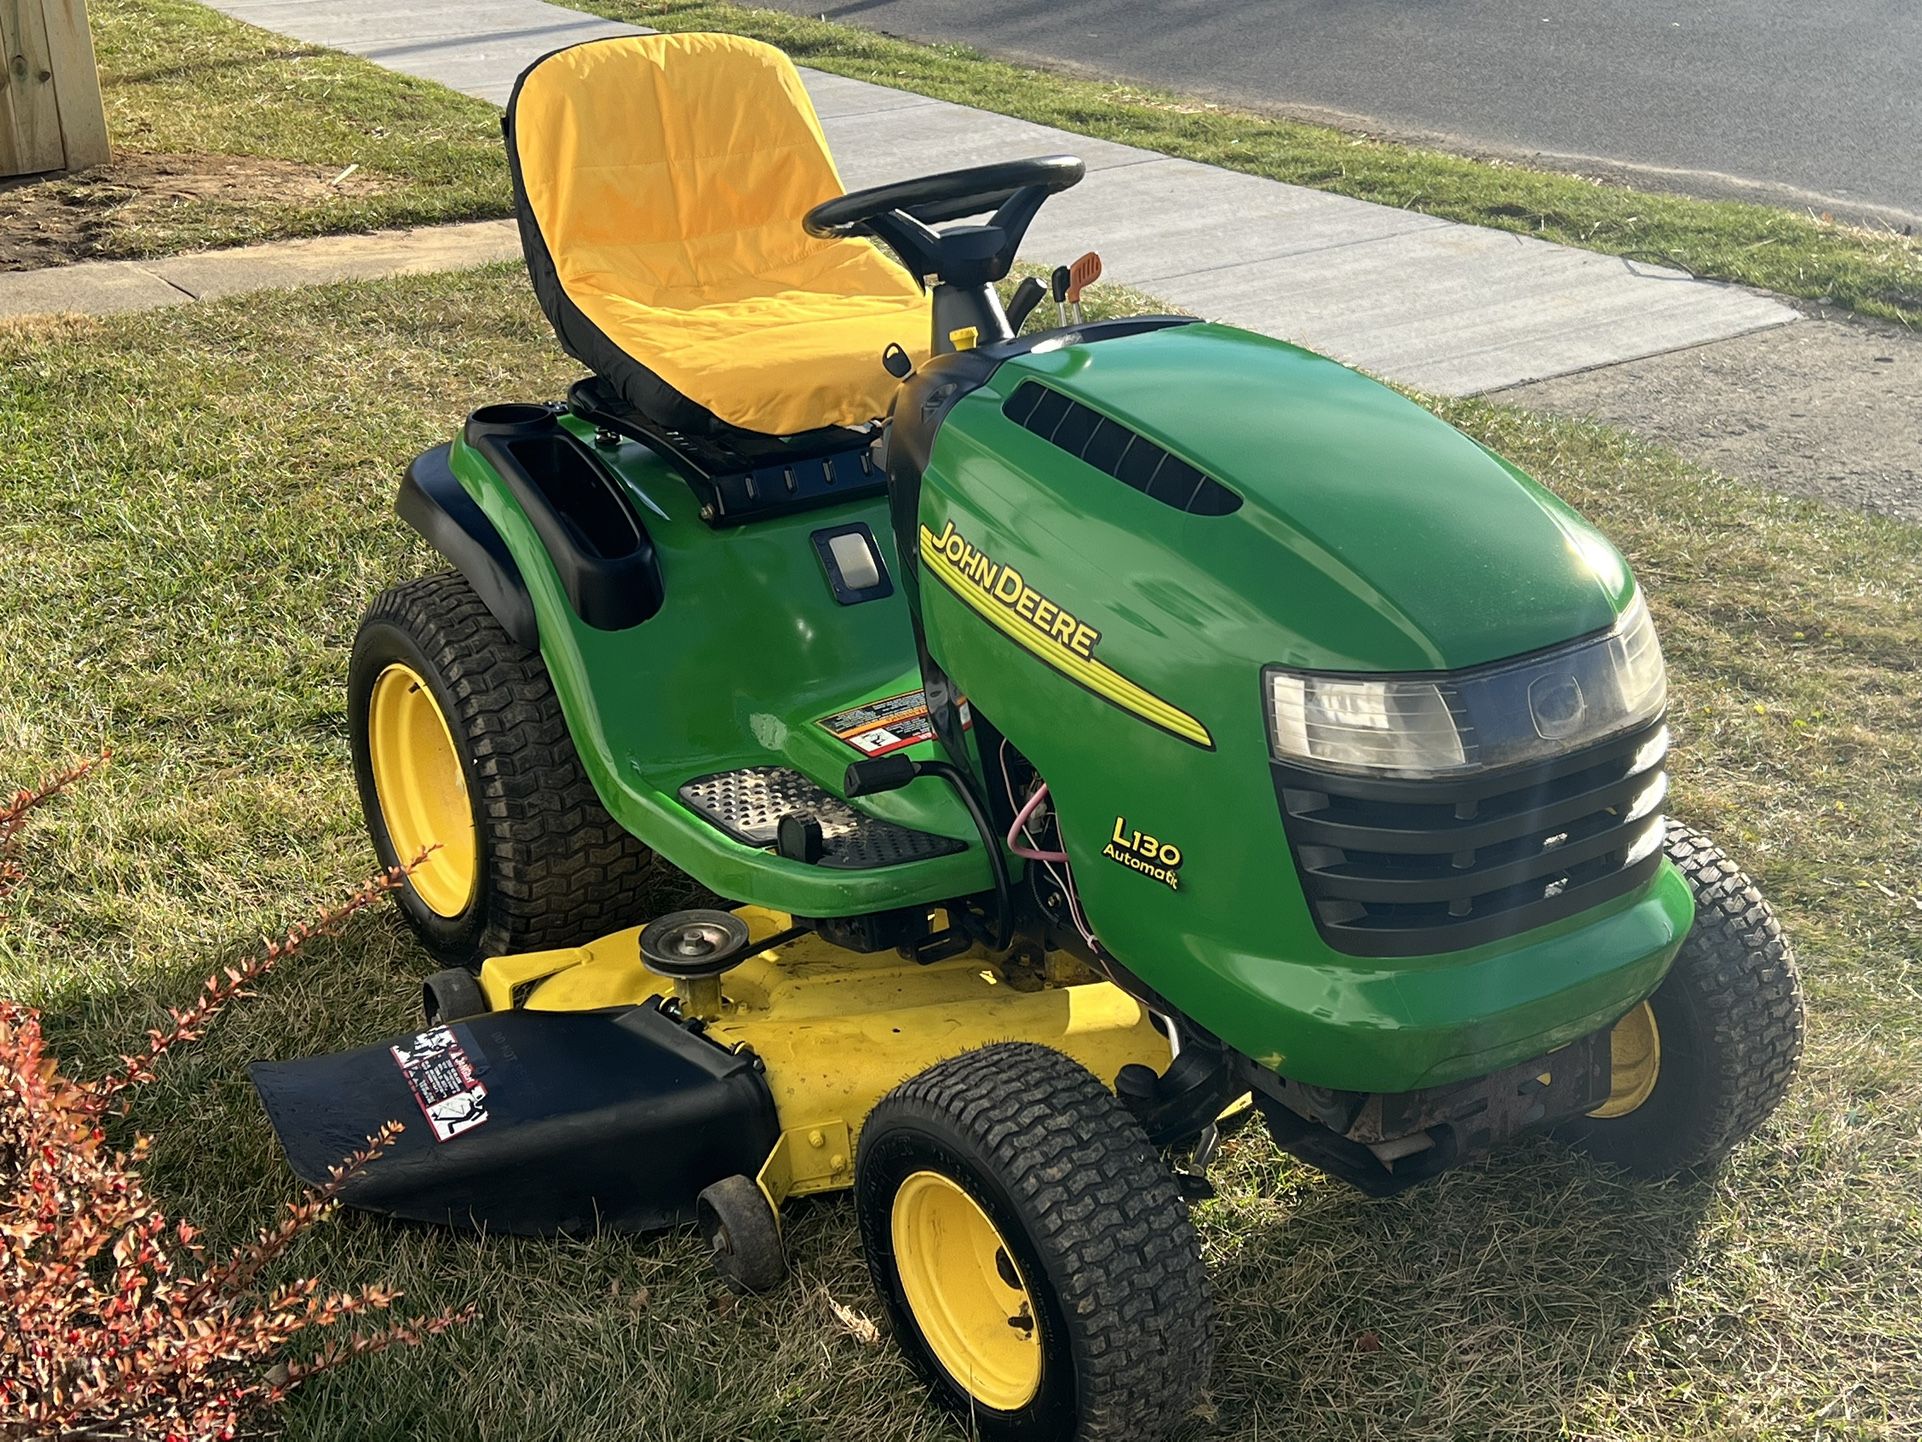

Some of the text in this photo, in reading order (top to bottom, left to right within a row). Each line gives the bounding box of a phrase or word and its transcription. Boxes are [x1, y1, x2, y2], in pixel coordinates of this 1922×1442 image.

[931, 520, 1099, 658] JOHN DEERE
[1112, 816, 1181, 866] L130
